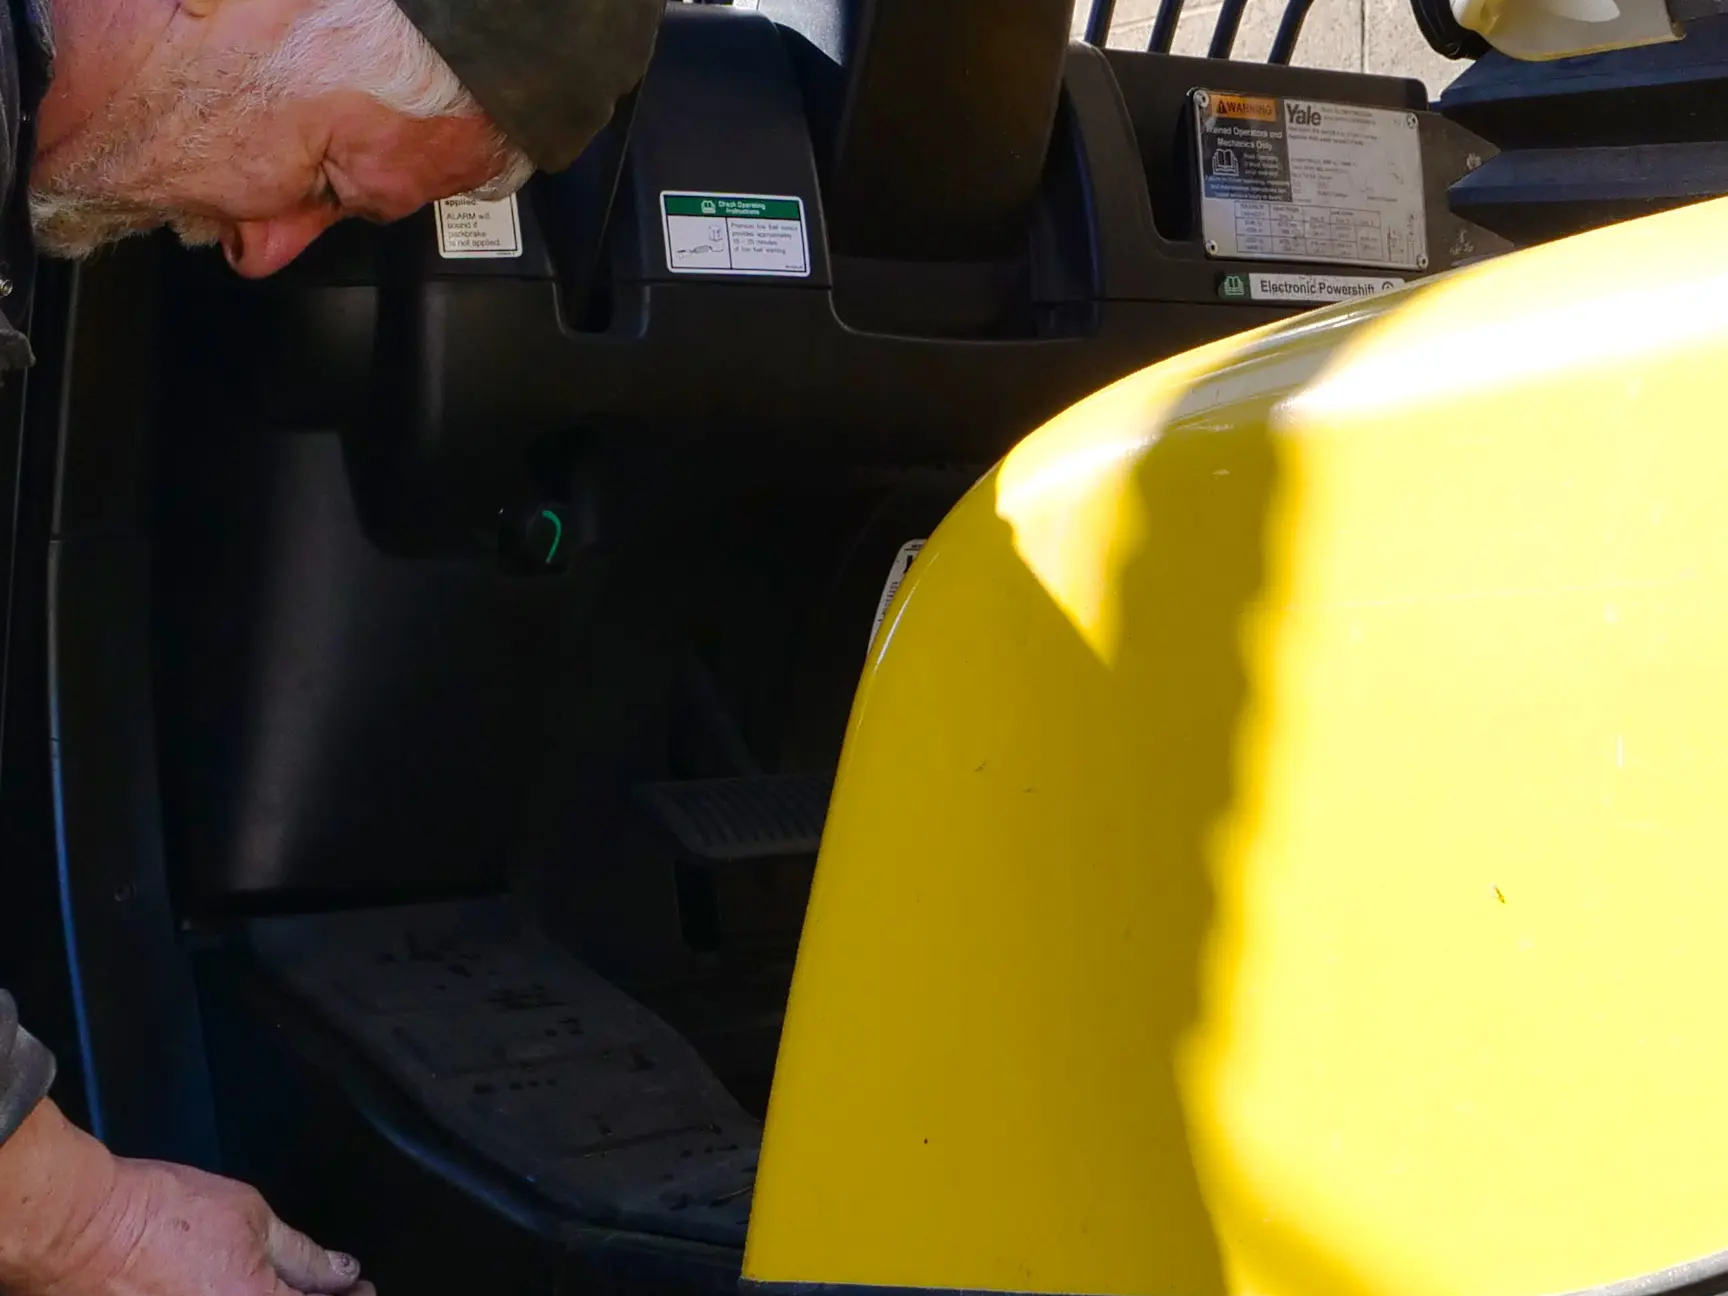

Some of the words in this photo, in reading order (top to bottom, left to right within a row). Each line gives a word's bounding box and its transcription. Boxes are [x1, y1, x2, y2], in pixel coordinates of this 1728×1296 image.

[1226, 101, 1272, 115] WARNING
[1286, 103, 1321, 126] Yale
[1233, 127, 1269, 138] Operators
[1269, 131, 1283, 139] and
[1217, 137, 1254, 148] Mechanics
[1256, 141, 1272, 151] Only
[718, 200, 737, 208] Check
[737, 201, 766, 211] Operating
[446, 212, 476, 220] ALARM
[478, 212, 491, 220] will
[1260, 279, 1316, 295] Electronic
[1319, 283, 1374, 297] Powershift
